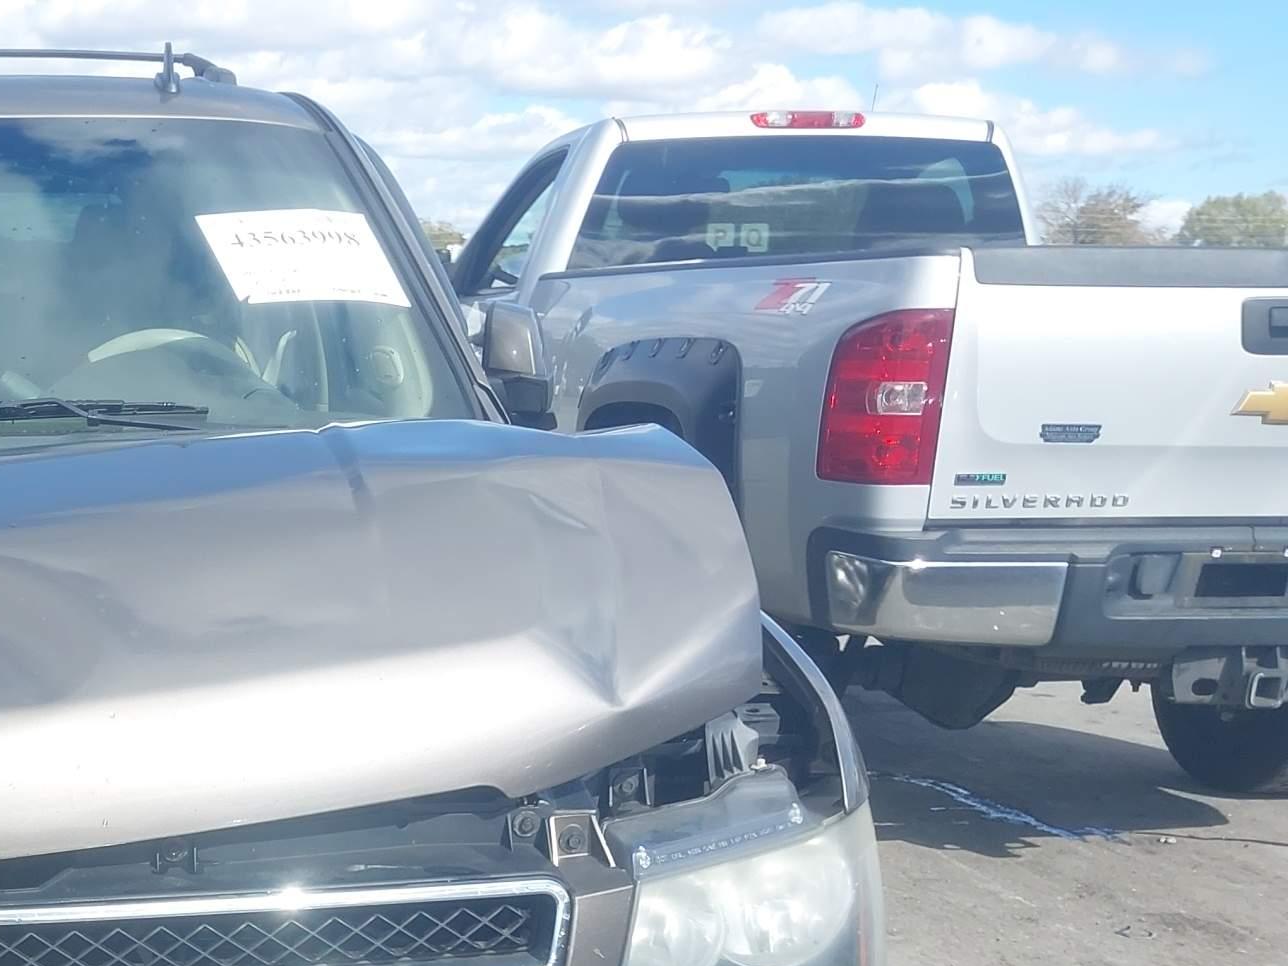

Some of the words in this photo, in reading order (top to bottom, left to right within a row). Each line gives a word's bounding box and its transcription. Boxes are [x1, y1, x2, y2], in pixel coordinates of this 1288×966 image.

[230, 229, 362, 249] 43563998
[754, 276, 832, 311] Z71
[949, 492, 1131, 510] SILVERADO
